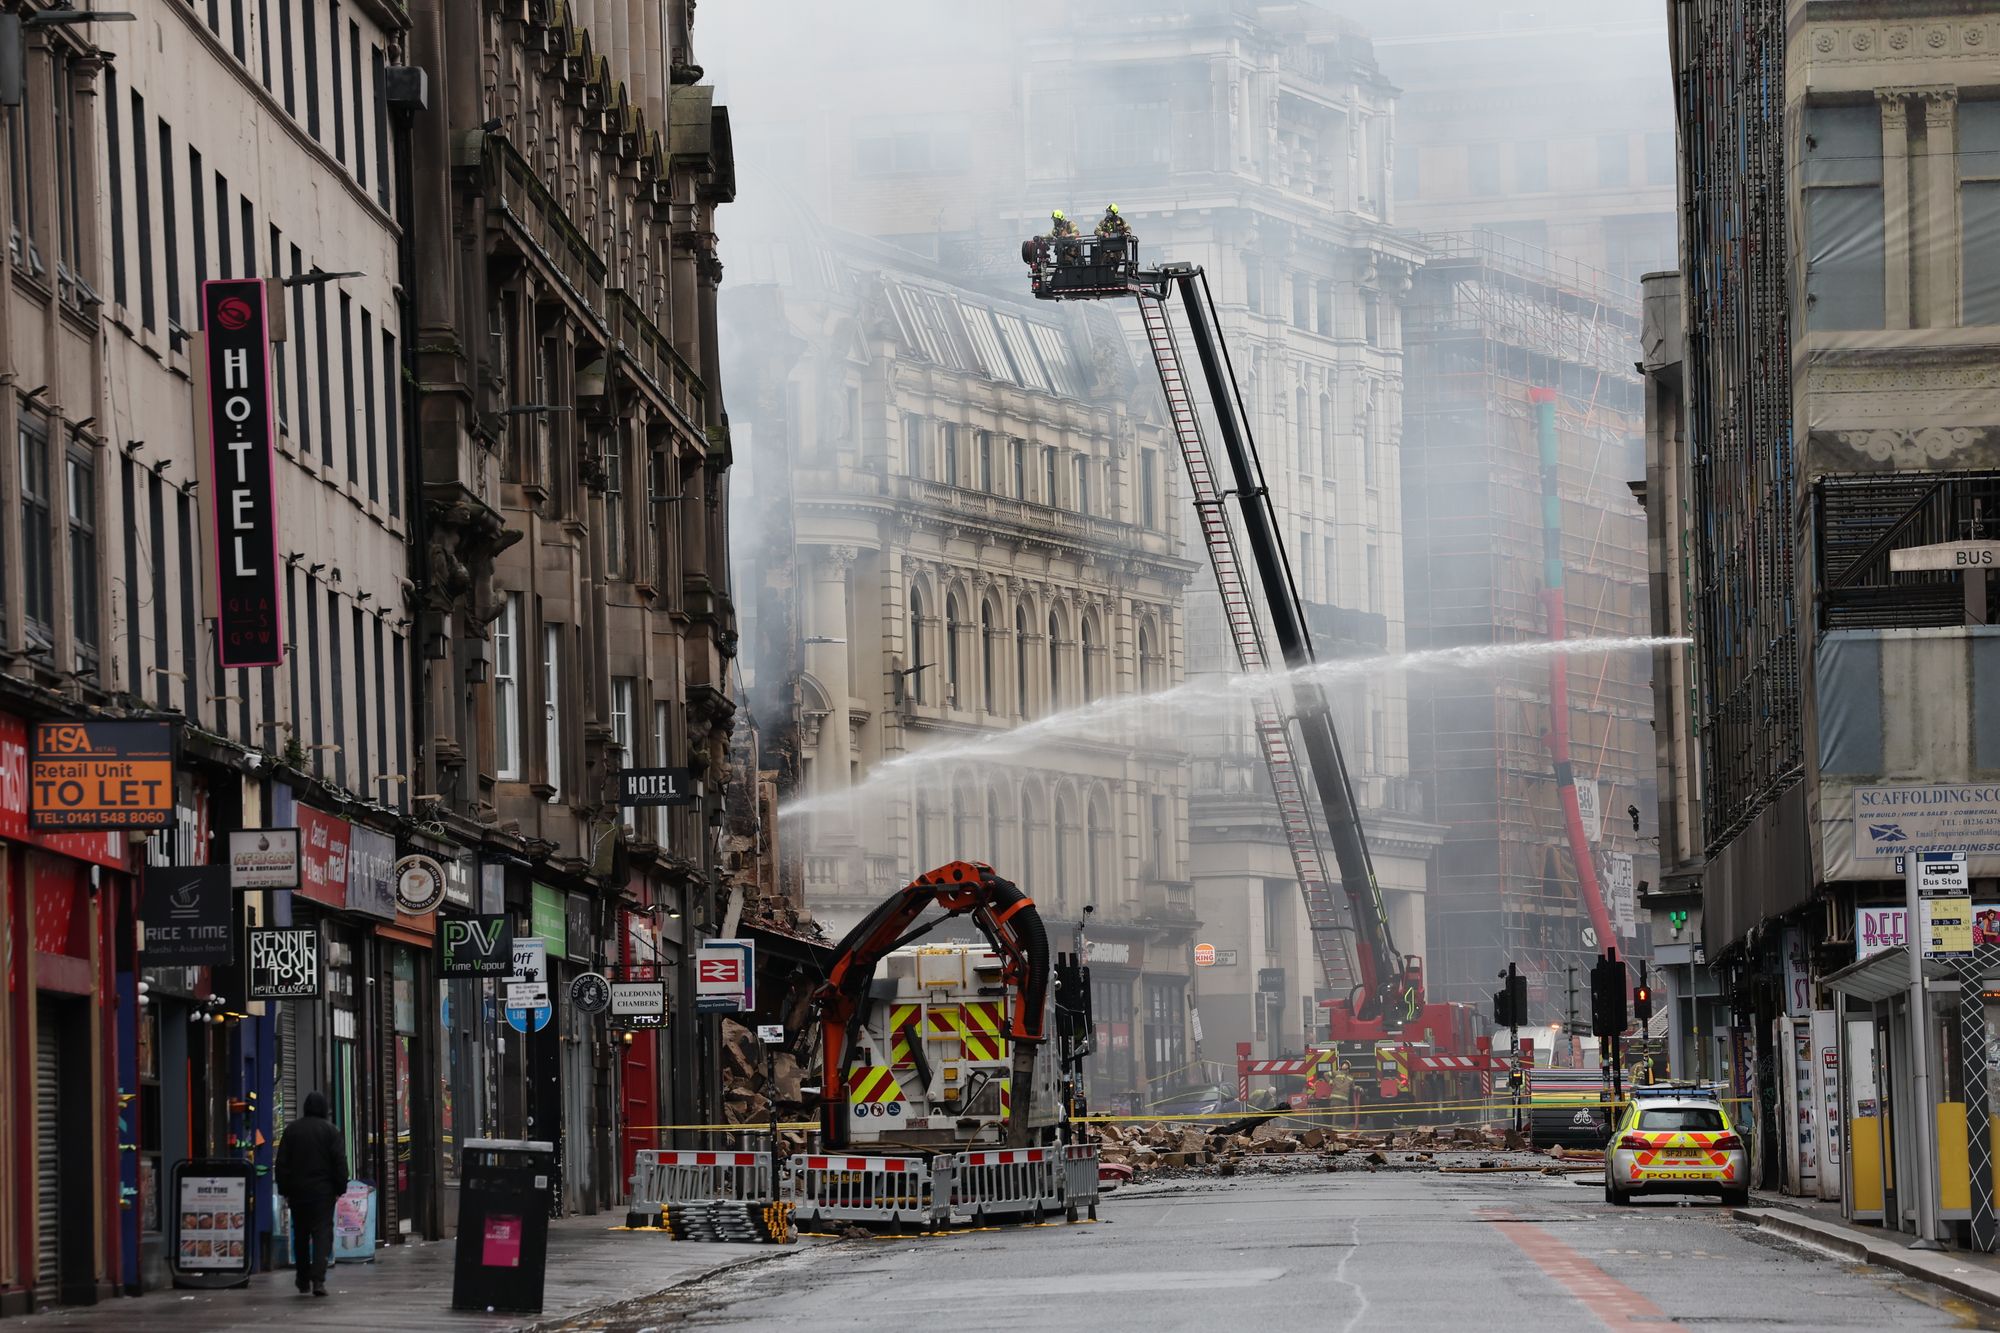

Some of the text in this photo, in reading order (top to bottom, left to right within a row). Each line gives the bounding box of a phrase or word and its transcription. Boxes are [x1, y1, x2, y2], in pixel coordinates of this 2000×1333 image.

[1957, 551, 1992, 565] BUS
[38, 727, 92, 752] HSA
[35, 763, 132, 777] Retail Unit
[35, 780, 162, 806] TO LET
[628, 775, 676, 795] HOTEL
[1862, 789, 1970, 806] SCAFFOLDING
[35, 811, 166, 824] TEL: 0141 548 8060
[1923, 878, 1962, 886] Bus Stop
[187, 925, 228, 939] TIME
[251, 930, 316, 951] RENNIE
[443, 919, 505, 957] PV
[251, 949, 316, 969] MACKIN
[443, 957, 506, 973] Prime Vapour
[514, 951, 534, 965] Off
[270, 966, 316, 986] TOSH
[254, 984, 314, 994] HOTEL GLASGOW
[572, 976, 591, 998] CENTRAL
